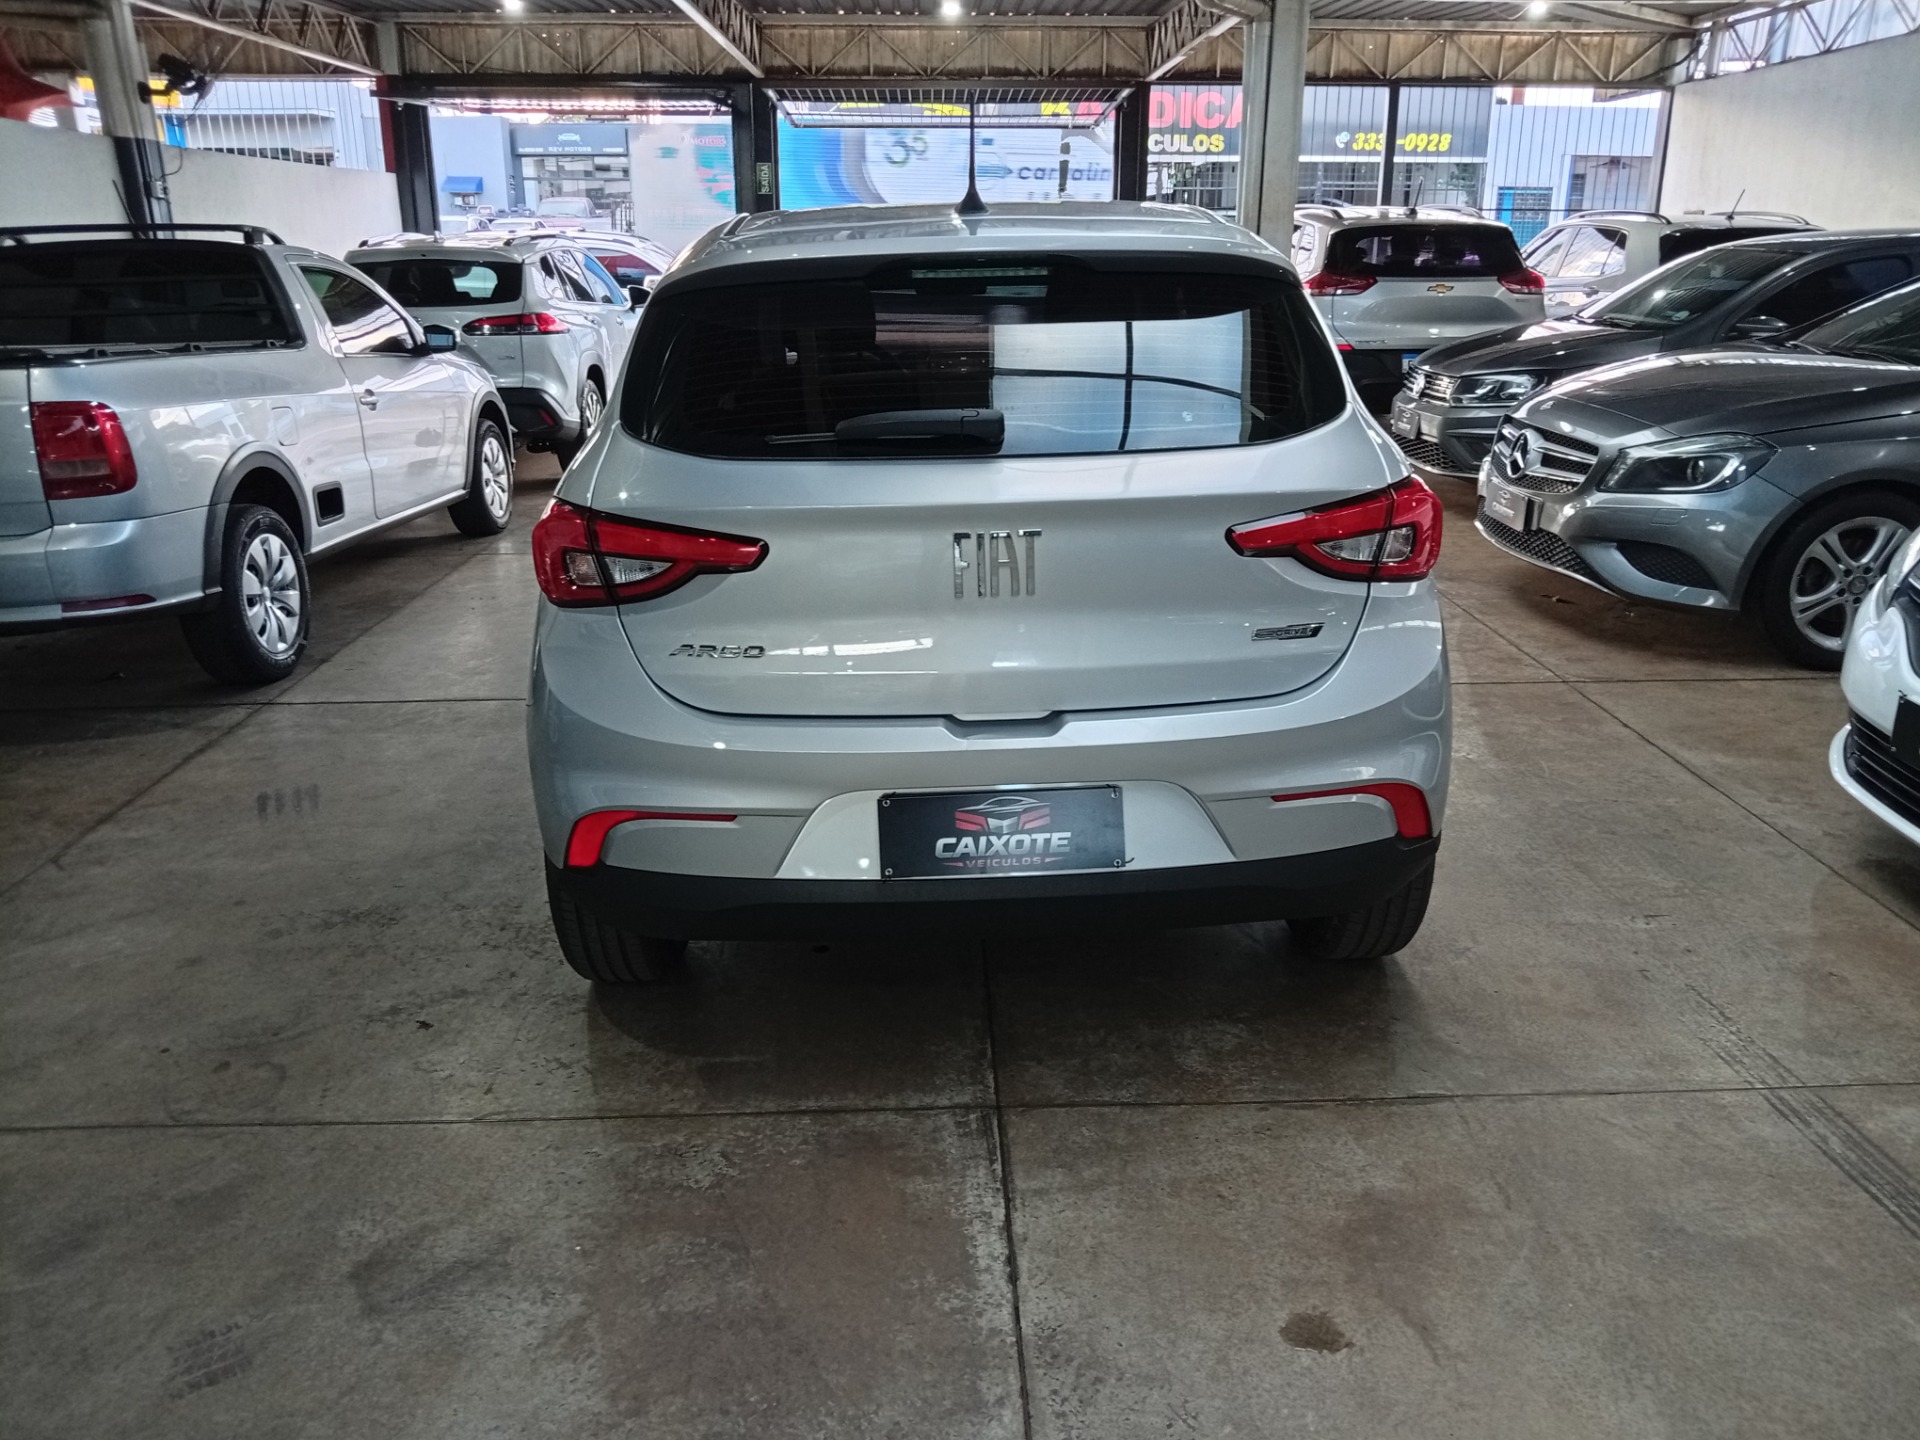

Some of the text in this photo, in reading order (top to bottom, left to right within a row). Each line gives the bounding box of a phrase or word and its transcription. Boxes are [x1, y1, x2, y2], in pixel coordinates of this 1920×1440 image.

[1352, 132, 1451, 152] 333-0928
[953, 529, 1043, 600] FIAT
[668, 643, 766, 659] ARGO
[934, 831, 1072, 859] CAIXOTE
